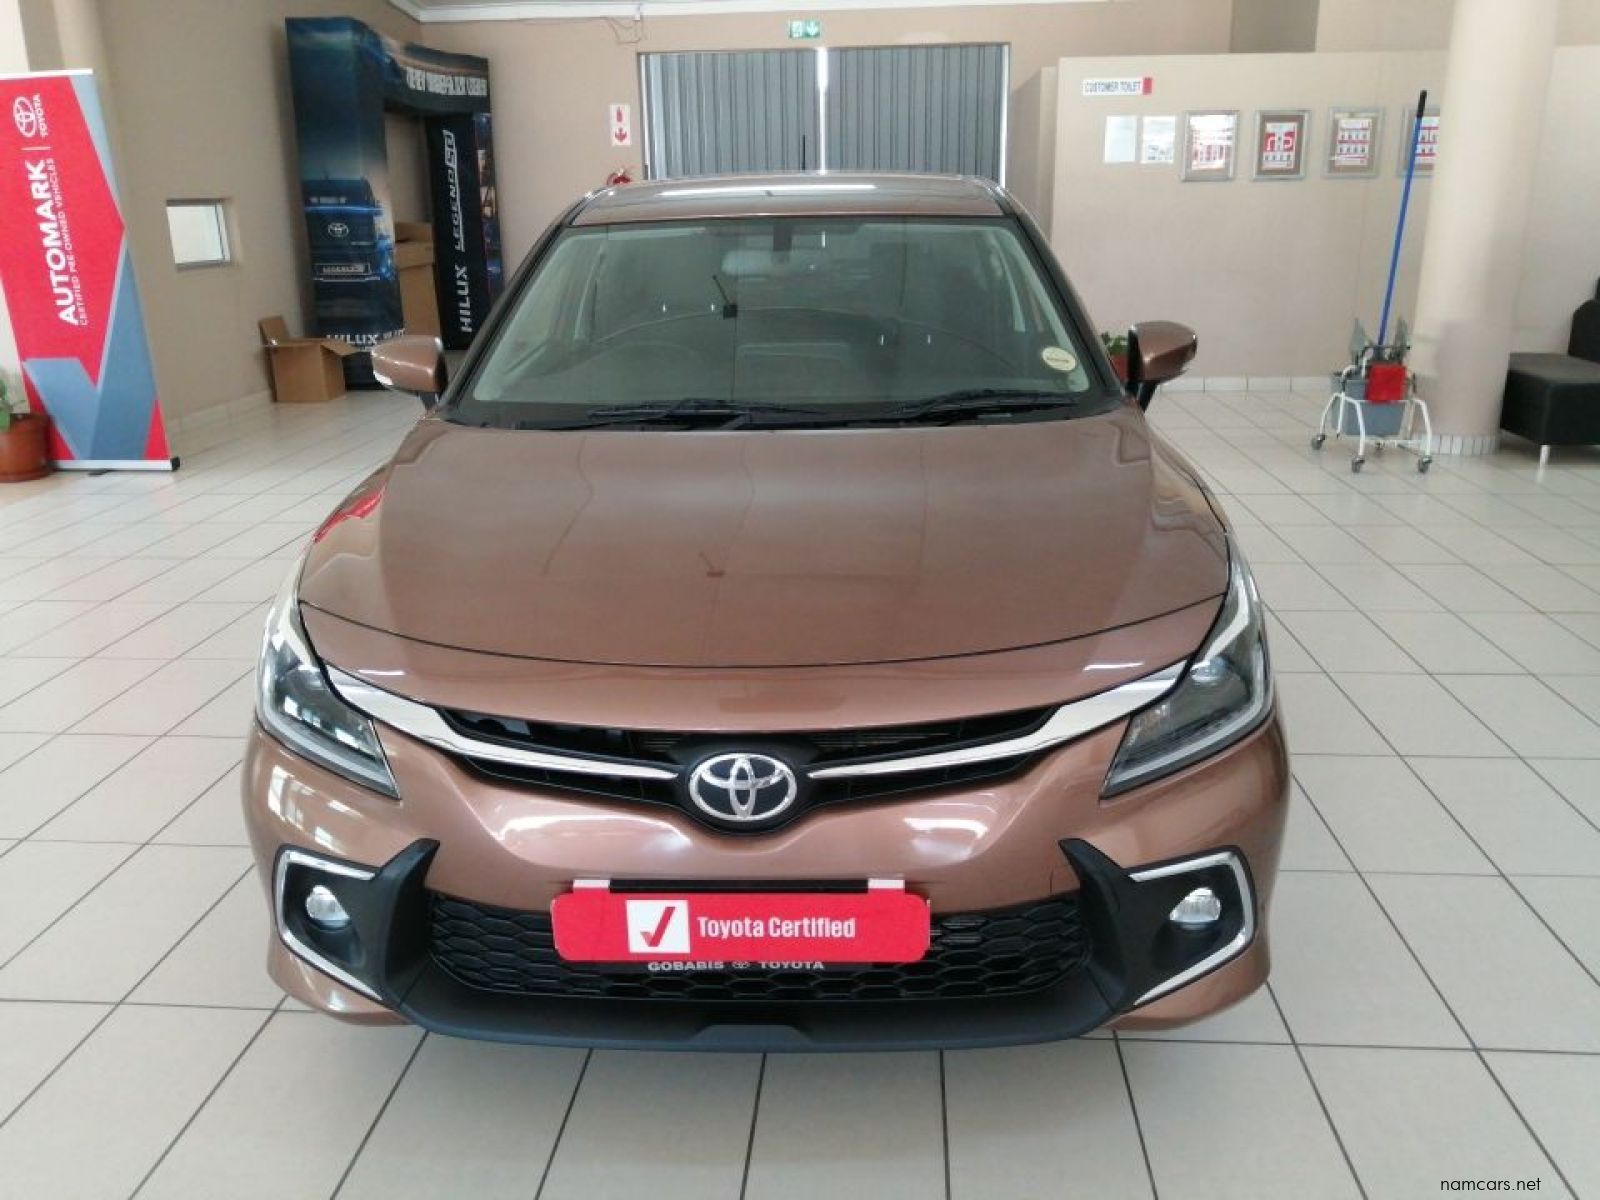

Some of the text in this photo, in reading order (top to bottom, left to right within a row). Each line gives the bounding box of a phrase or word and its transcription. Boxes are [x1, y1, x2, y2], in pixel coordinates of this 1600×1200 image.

[32, 93, 48, 138] TOYOTA
[46, 158, 63, 208] VEHICLES
[25, 159, 79, 326] AUTOMARK
[71, 276, 88, 326] CERTIFIED
[455, 264, 473, 333] HILUX
[697, 916, 856, 939] Toyota Certified
[647, 961, 825, 971] GOBABIS TOYOTA
